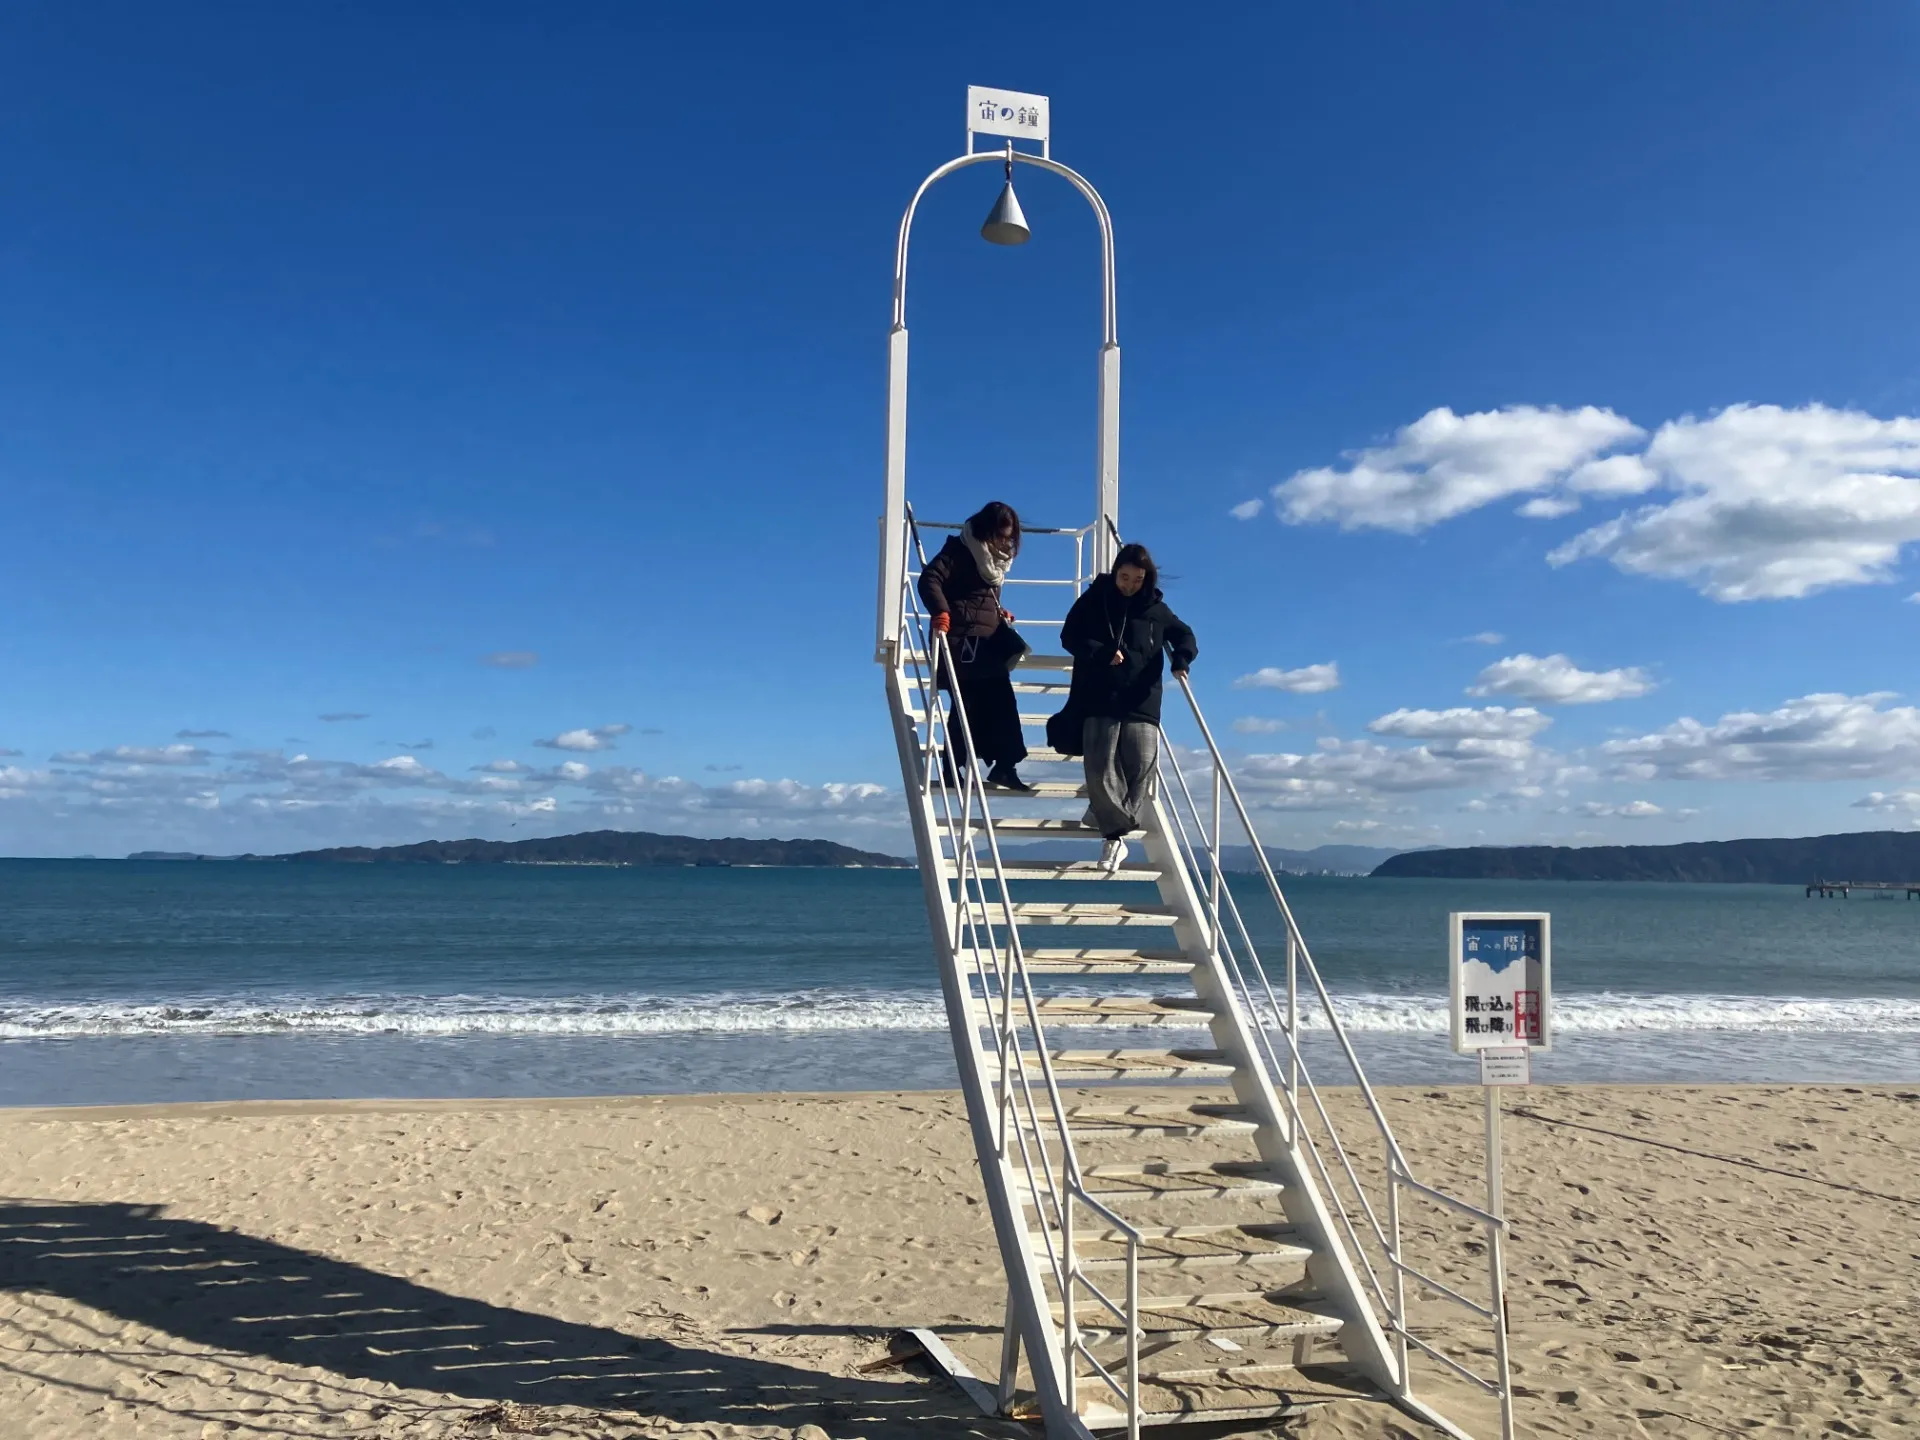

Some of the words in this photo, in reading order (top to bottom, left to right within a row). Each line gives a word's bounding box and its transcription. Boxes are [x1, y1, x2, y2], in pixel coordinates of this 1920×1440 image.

[978, 100, 1040, 128] 宙の鐘
[1465, 995, 1514, 1012] 飛び込み
[1517, 992, 1538, 1037] 禁止
[1465, 1016, 1514, 1033] 飛び降り
